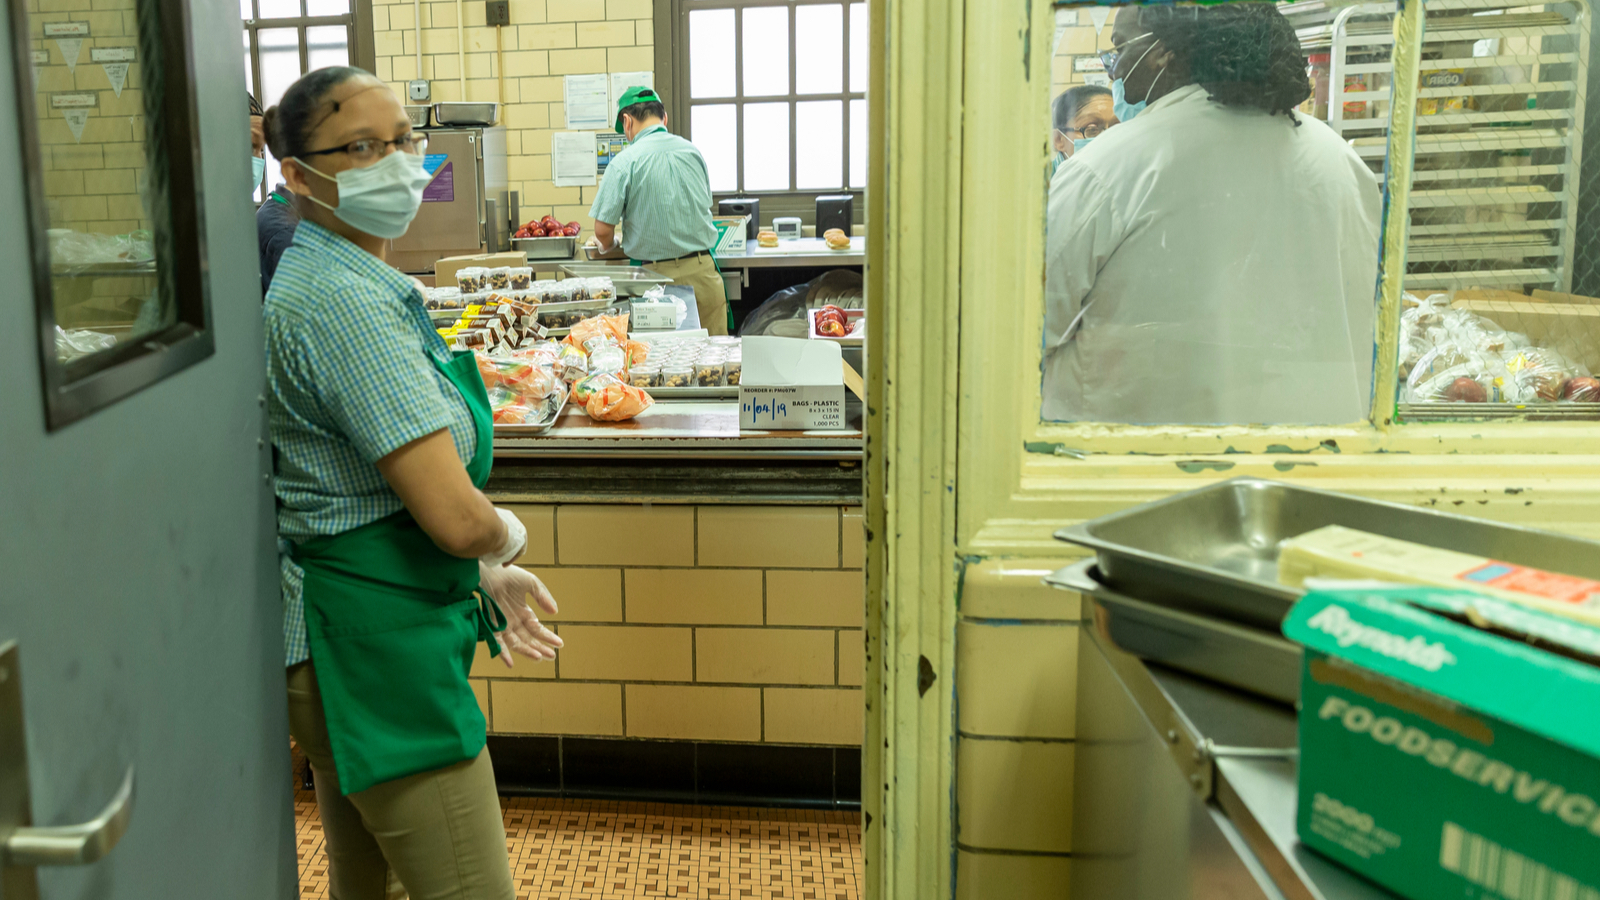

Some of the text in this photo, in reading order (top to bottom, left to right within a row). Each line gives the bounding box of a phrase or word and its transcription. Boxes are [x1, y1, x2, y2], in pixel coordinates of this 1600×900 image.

[1429, 74, 1460, 85] ARGO
[743, 397, 787, 424] 11/04/19
[1307, 604, 1456, 672] Reynolds
